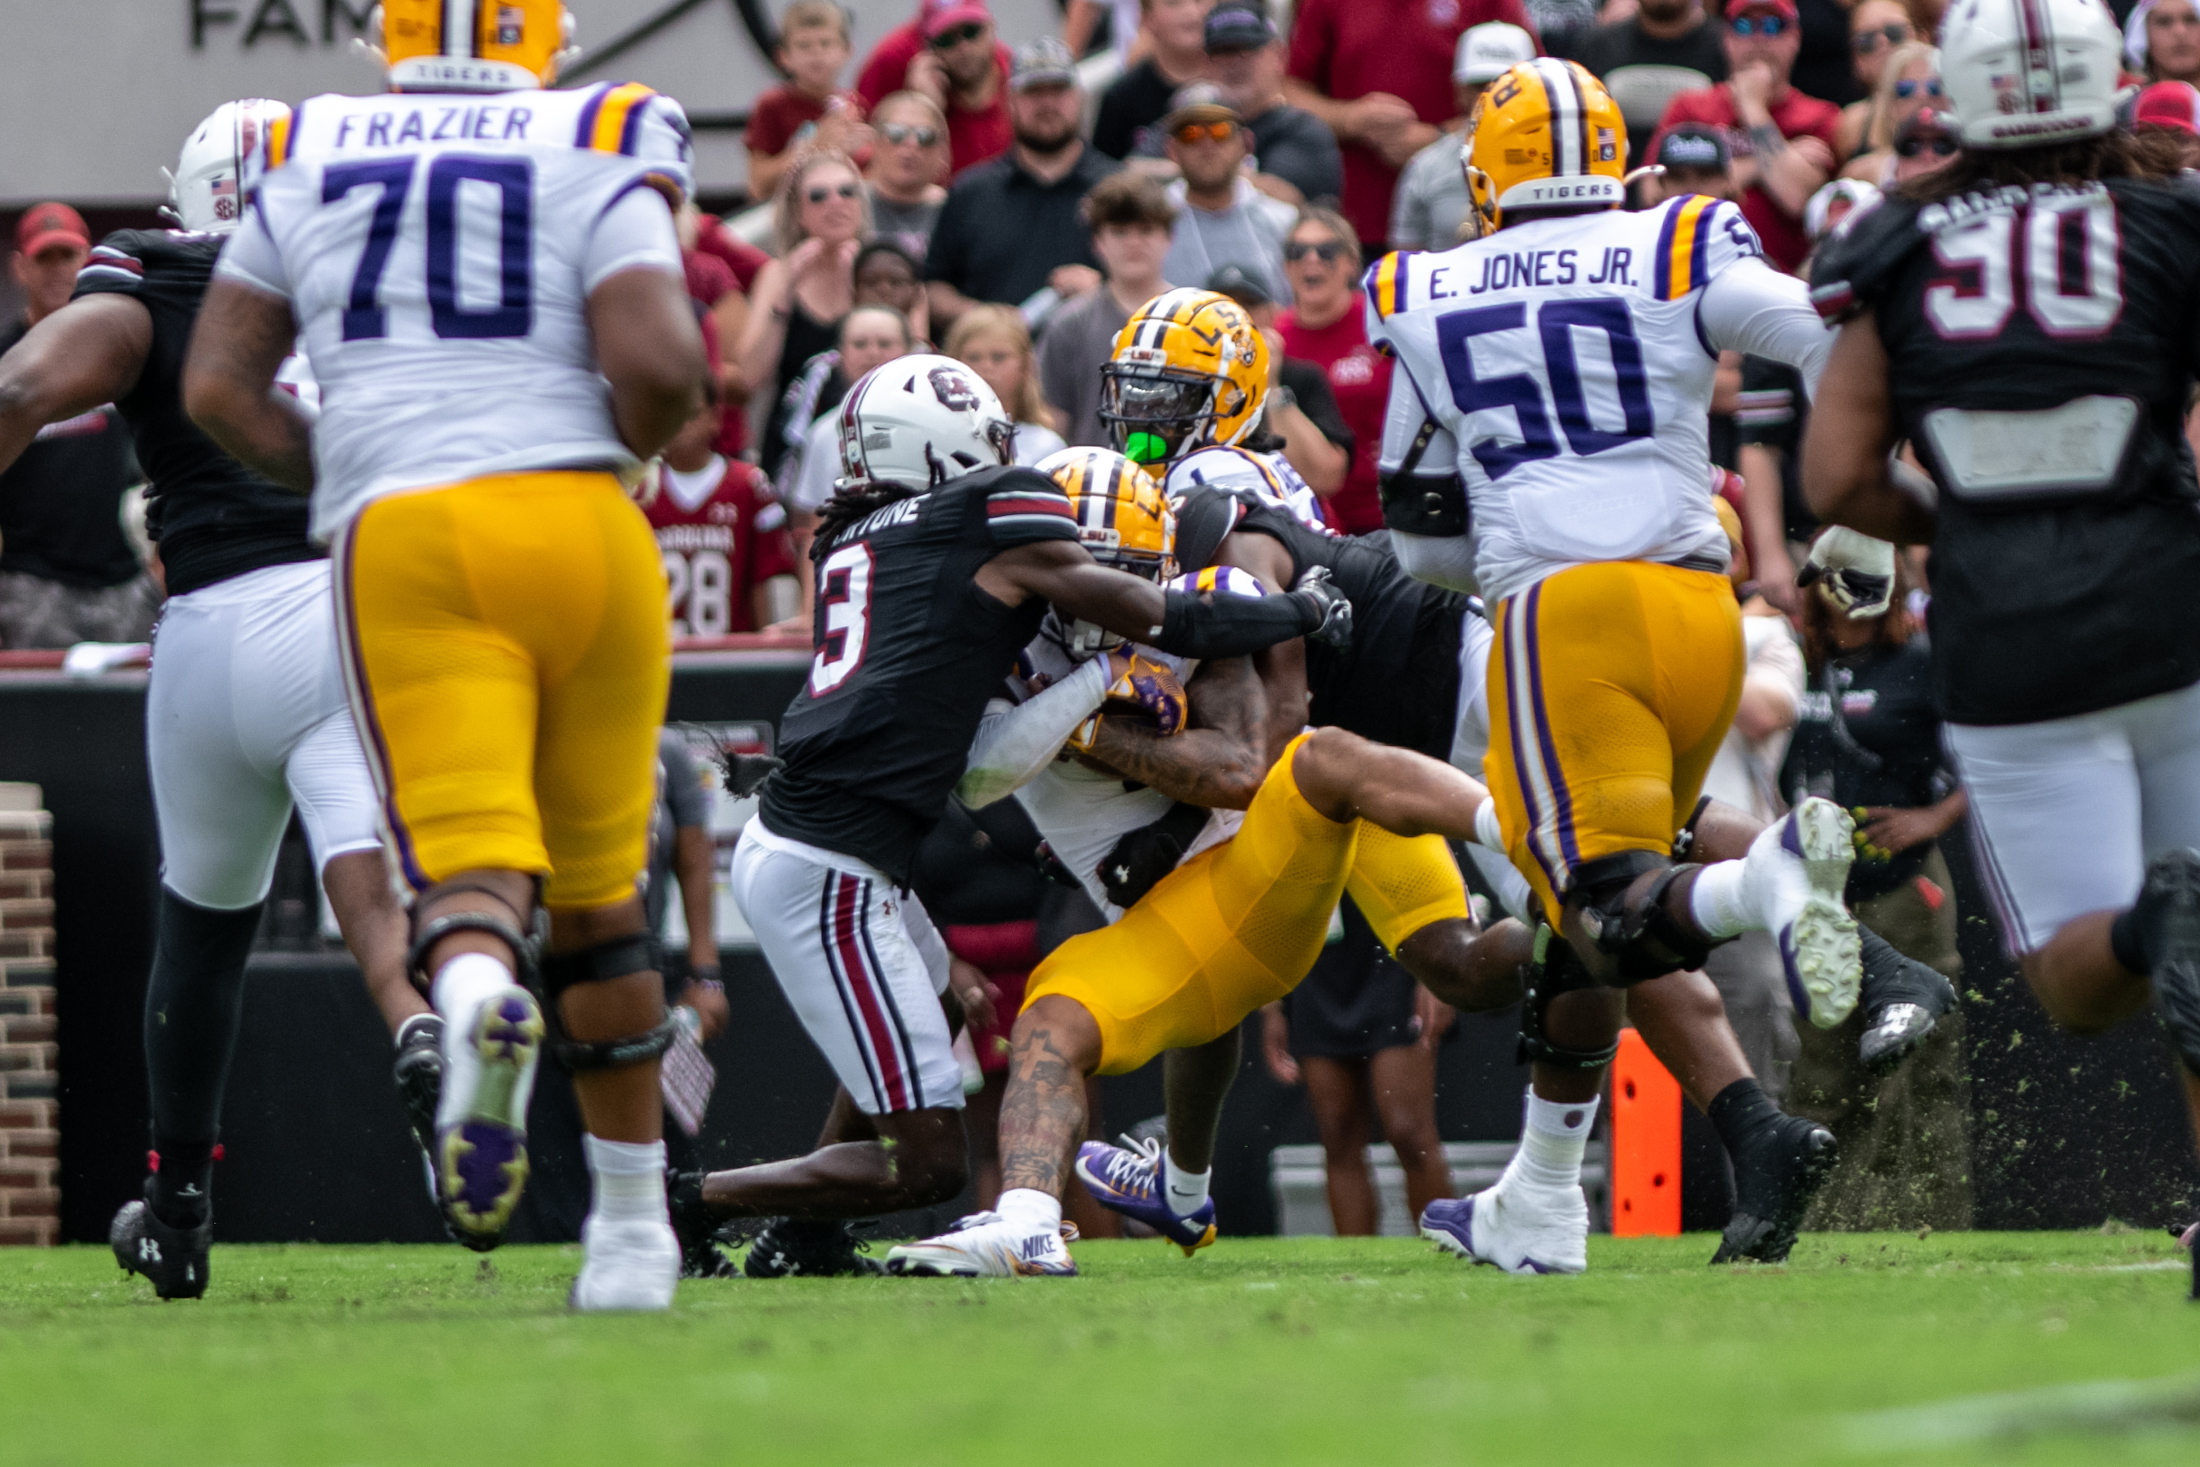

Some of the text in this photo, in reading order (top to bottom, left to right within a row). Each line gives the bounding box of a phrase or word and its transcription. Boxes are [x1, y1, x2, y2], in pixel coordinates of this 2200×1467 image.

[190, 0, 384, 50] FAM
[416, 64, 510, 83] TIGERS
[336, 105, 534, 148] FRAZIER
[1534, 184, 1613, 199] TIGERS
[322, 152, 537, 342] 70
[1922, 193, 2126, 340] 90
[1430, 247, 1639, 300] E. JONES JR.
[1131, 349, 1155, 361] LSU
[1436, 297, 1655, 482] 50
[1079, 529, 1107, 542] LSU
[809, 539, 877, 699] 3
[1022, 1233, 1056, 1260] NIKE
